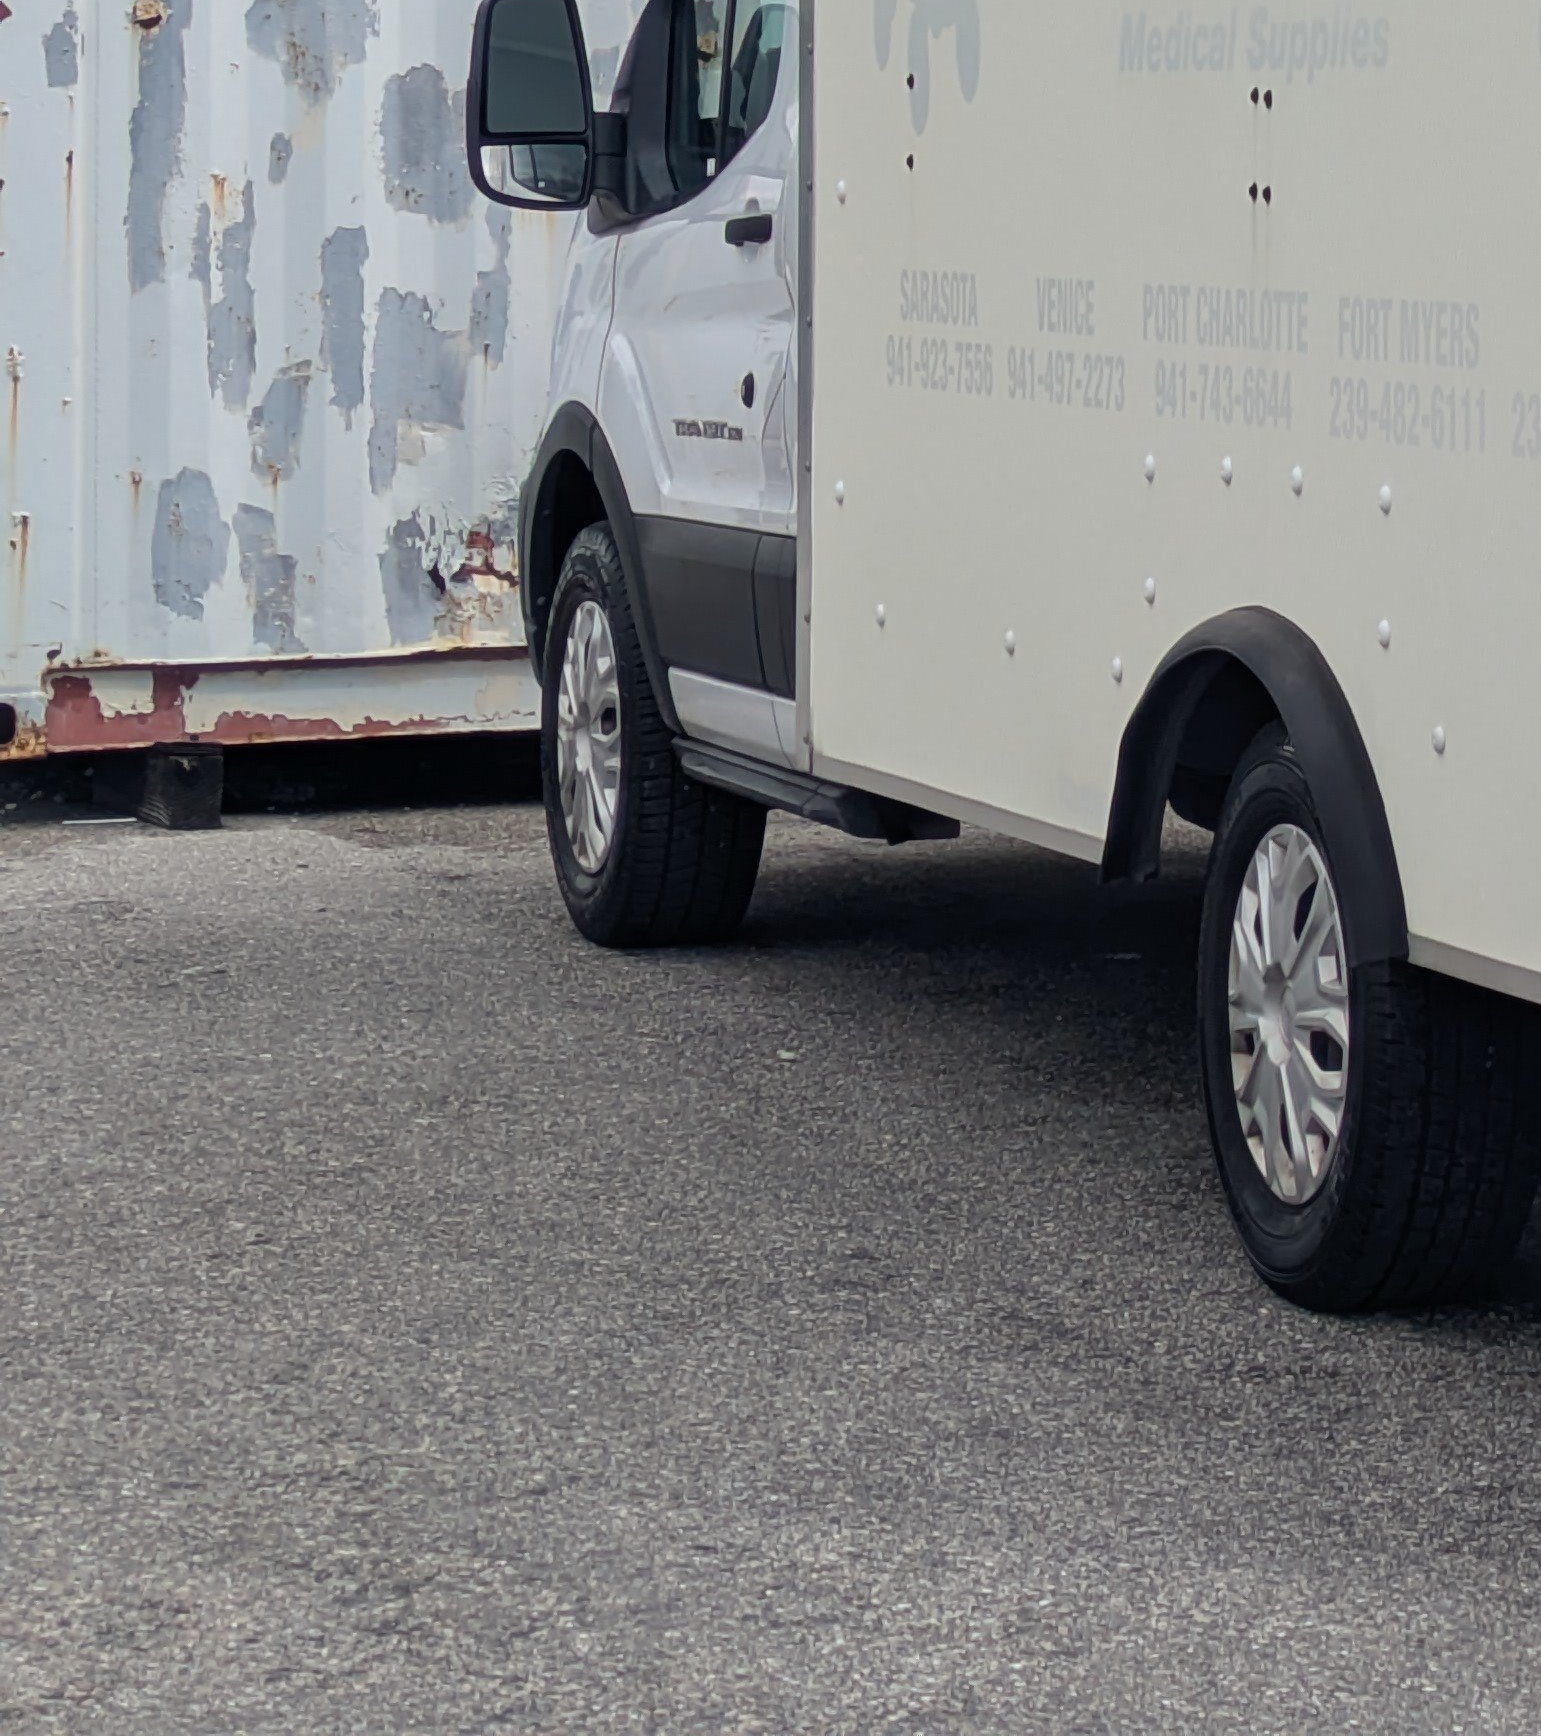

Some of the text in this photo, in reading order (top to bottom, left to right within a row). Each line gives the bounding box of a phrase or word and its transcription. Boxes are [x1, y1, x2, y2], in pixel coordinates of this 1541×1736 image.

[1118, 6, 1390, 85] Medical Supplies
[900, 269, 978, 327] SARASOTA
[1036, 277, 1095, 336] VENICE
[1143, 284, 1308, 353] PORT CHARLOTTE
[886, 334, 993, 396] 941-923-7556
[1338, 297, 1480, 369] FORT MYERS
[1007, 346, 1126, 412] 941-497-2273
[1155, 360, 1292, 430] 941-743-6644
[1329, 377, 1486, 454] 239-482-6111
